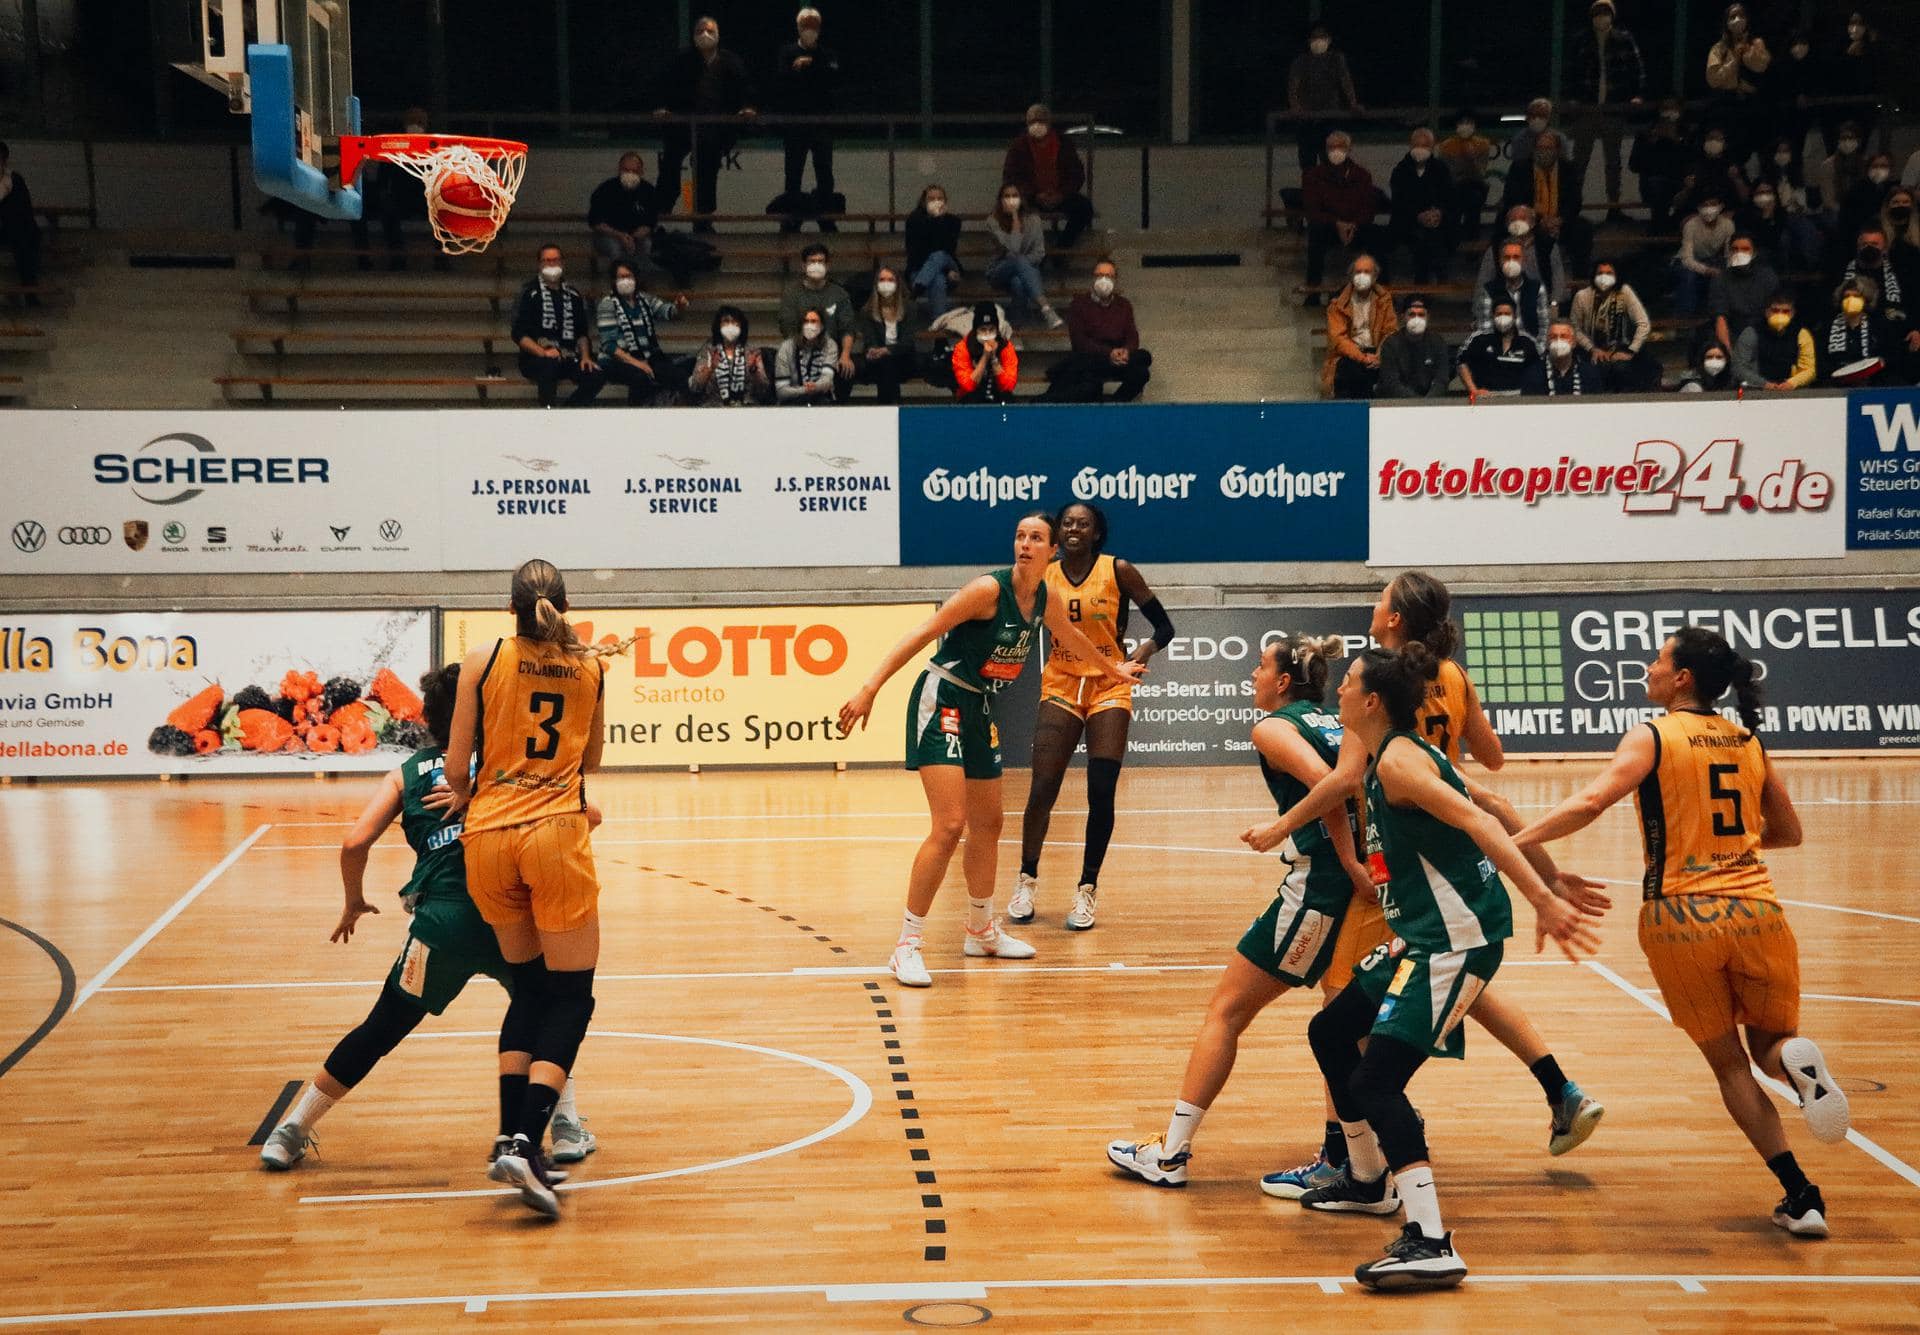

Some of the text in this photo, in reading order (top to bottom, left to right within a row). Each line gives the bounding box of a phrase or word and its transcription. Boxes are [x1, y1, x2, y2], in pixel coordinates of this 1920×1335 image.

[94, 453, 330, 484] SCHERER
[1860, 459, 1898, 474] WHS
[472, 478, 592, 495] J.S. PERSONAL
[624, 477, 742, 494] J.S. PERSONAL
[774, 476, 891, 492] J.S. PERSONAL
[922, 466, 1048, 507] Gothaer
[1072, 465, 1197, 506] Gothaer
[1220, 463, 1345, 504] Gothaer
[497, 499, 568, 515] SERVICE
[649, 498, 719, 514] SERVICE
[799, 496, 868, 512] SERVICE
[1858, 508, 1893, 519] Rafael
[1068, 598, 1082, 623] 9
[73, 627, 198, 672] Bona
[634, 624, 849, 678] LOTTO
[633, 684, 726, 704] Saartoto
[1215, 680, 1237, 697] im
[0, 693, 113, 710] via GmbH
[11, 718, 33, 728] und
[36, 717, 85, 728] Gemüse
[525, 691, 565, 761] 3
[676, 714, 731, 743] des
[1484, 707, 1565, 736] LIMATE
[1787, 704, 1872, 731] POWER
[1128, 740, 1206, 753] Neunkirchen
[1708, 763, 1746, 837] 5
